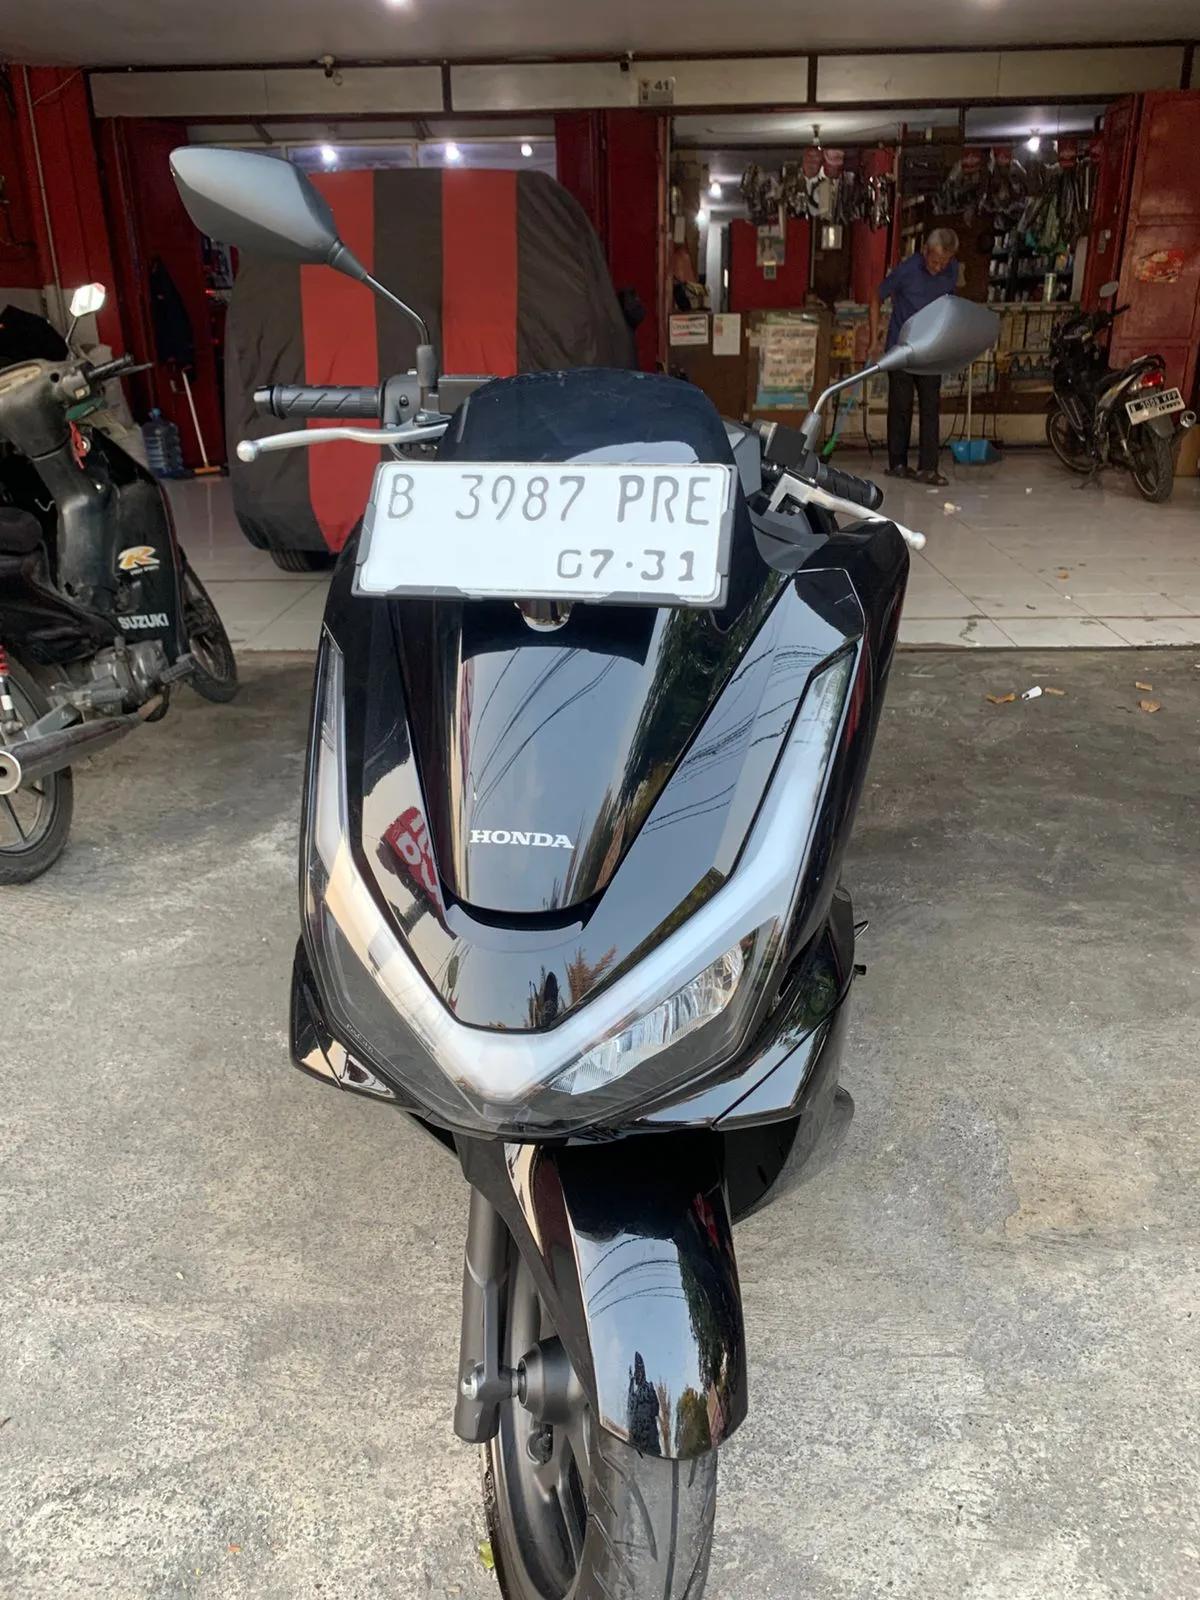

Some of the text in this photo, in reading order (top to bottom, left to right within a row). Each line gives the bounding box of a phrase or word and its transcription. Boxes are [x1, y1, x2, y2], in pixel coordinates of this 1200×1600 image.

[387, 473, 711, 526] B 3987 PRE
[118, 612, 169, 630] SUZUKI
[469, 829, 575, 850] HONDA
